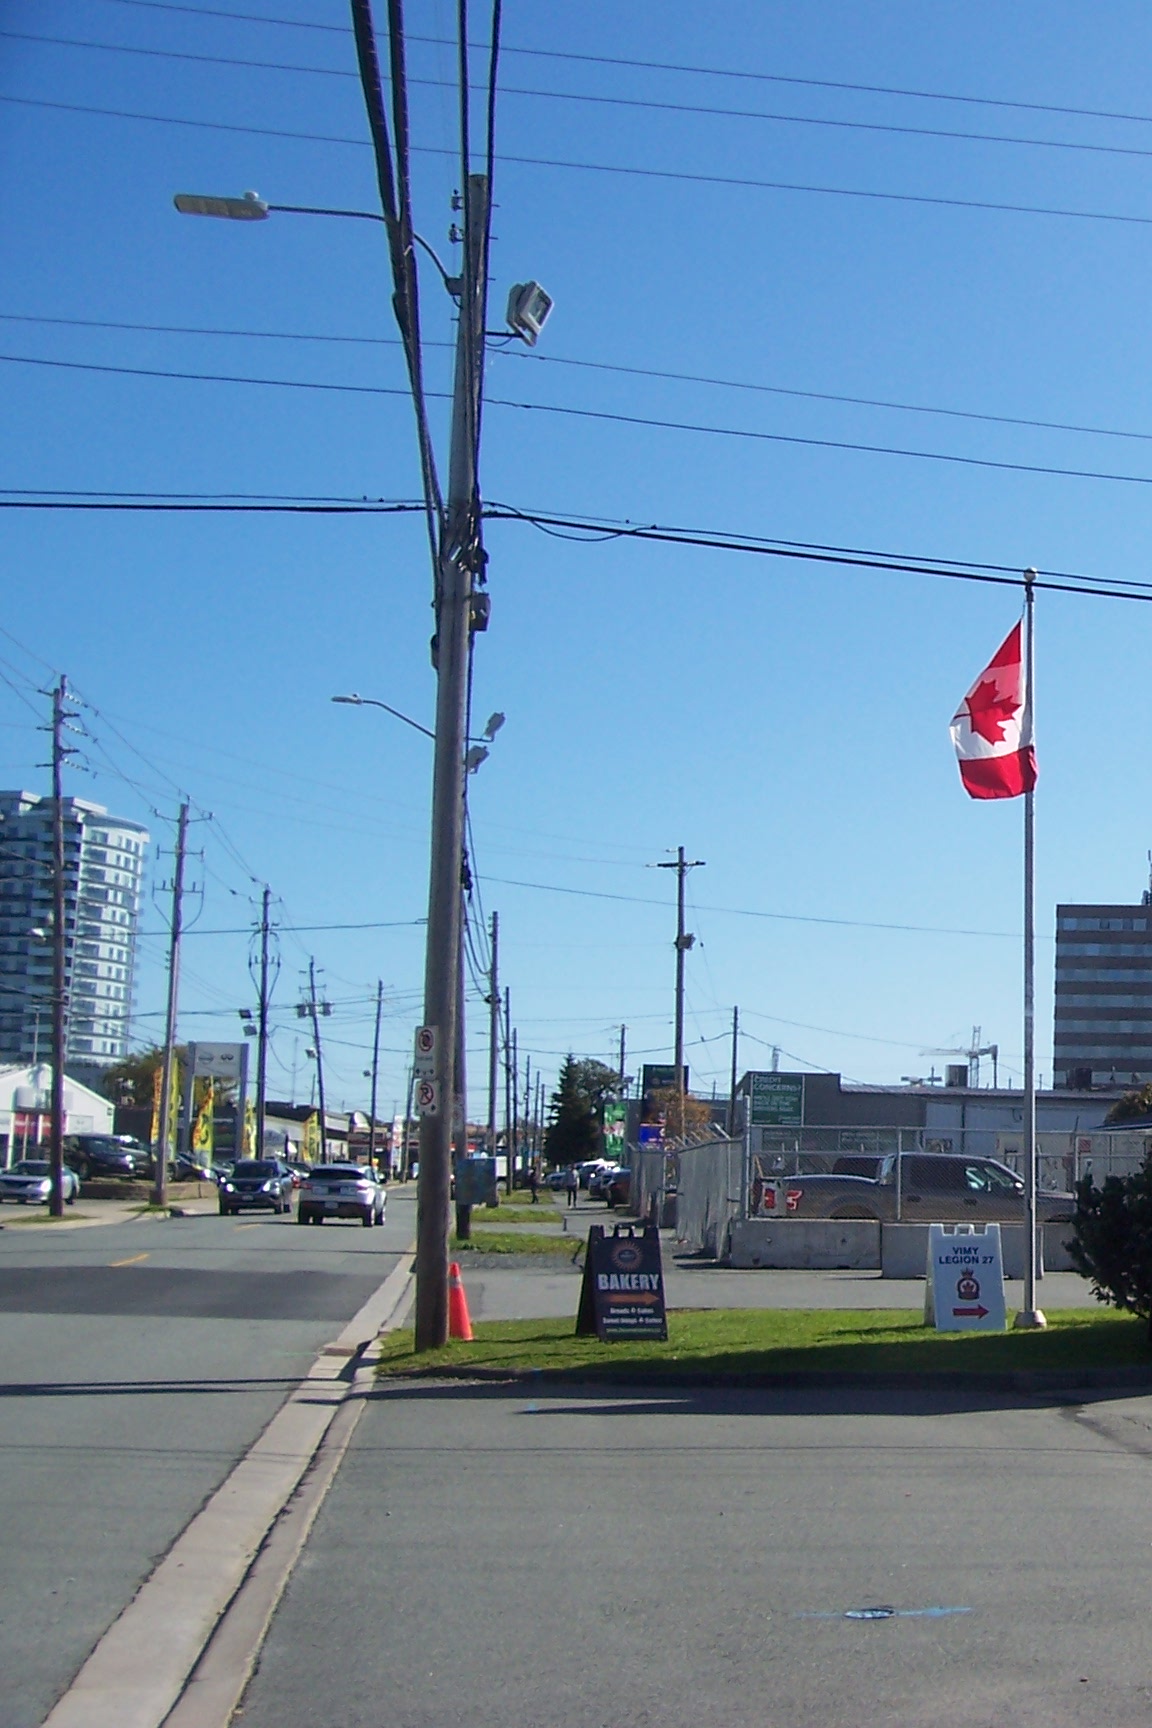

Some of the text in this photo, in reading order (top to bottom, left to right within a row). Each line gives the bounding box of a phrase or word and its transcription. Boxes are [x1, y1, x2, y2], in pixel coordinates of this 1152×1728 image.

[952, 1246, 980, 1255] VIMY
[938, 1255, 994, 1265] LEGION 27
[597, 1273, 660, 1290] BAKERY
